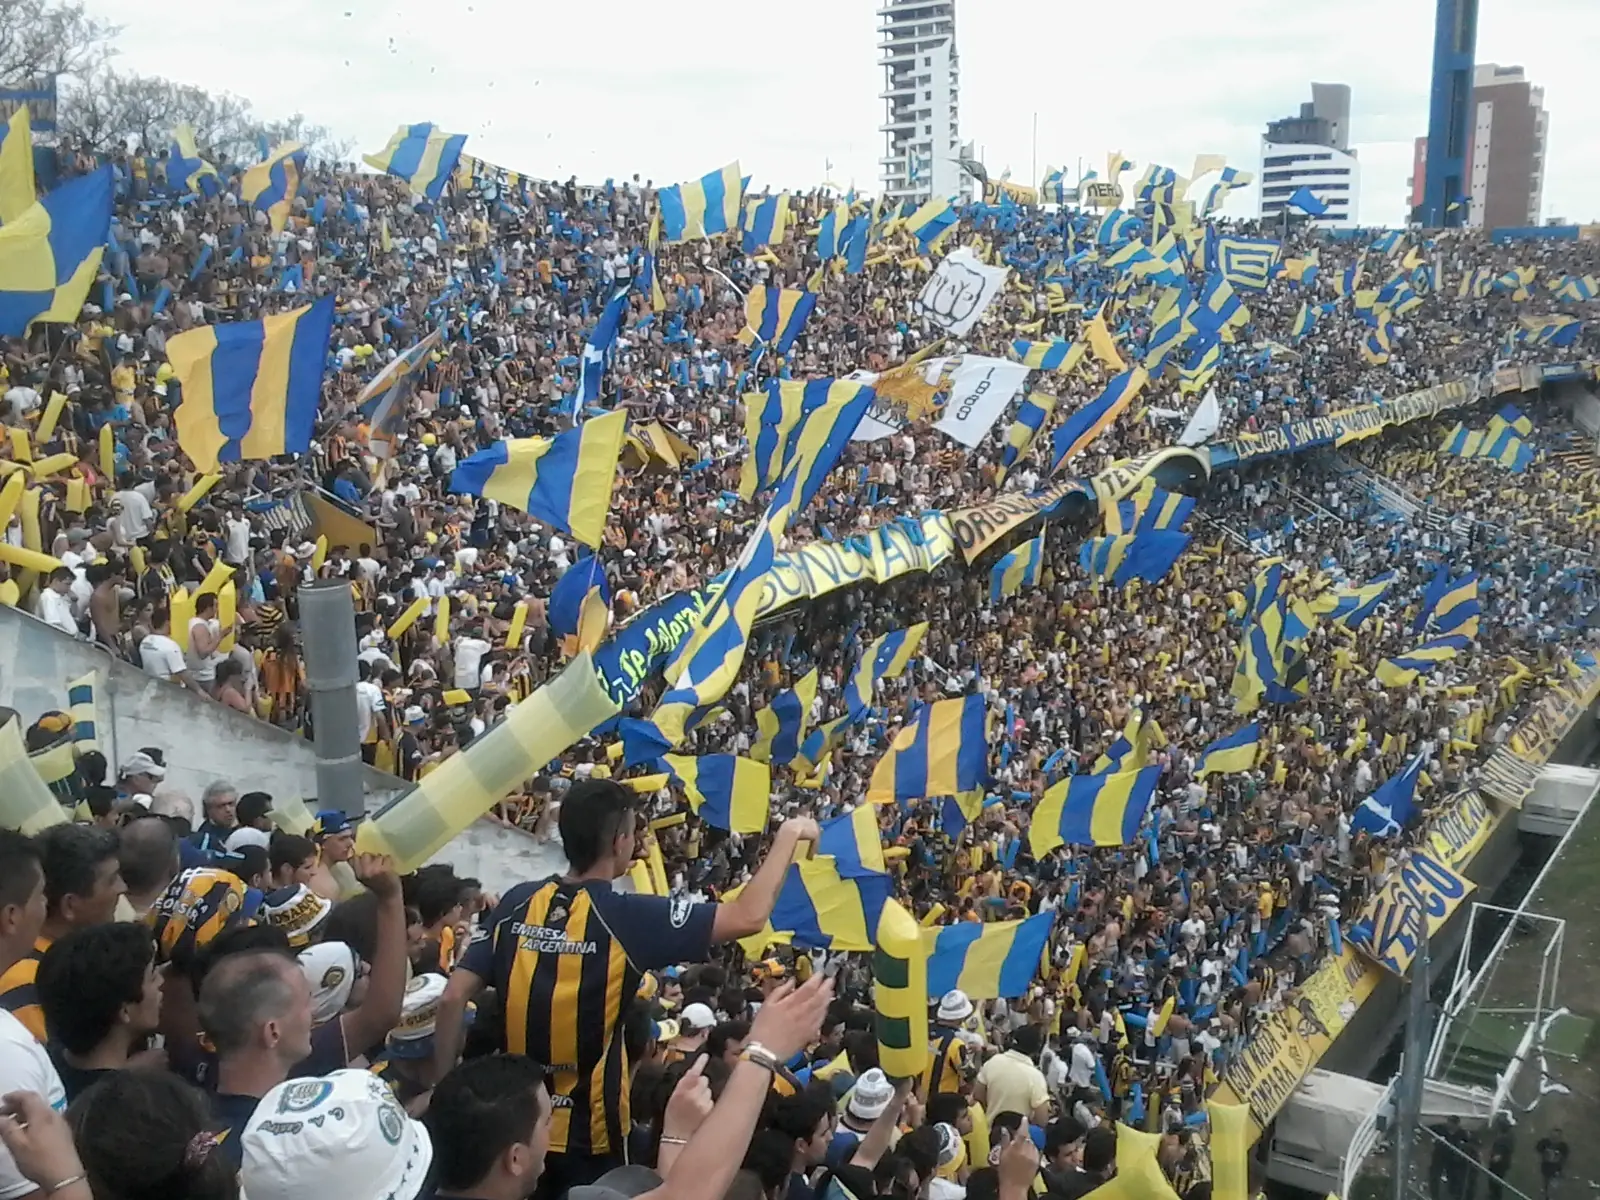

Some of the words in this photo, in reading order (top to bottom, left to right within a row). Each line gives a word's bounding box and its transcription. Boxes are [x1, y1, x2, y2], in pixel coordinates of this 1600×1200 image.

[956, 367, 995, 421] 1889
[510, 921, 568, 942] EMPRESA
[519, 938, 597, 955] ARGENTINA
